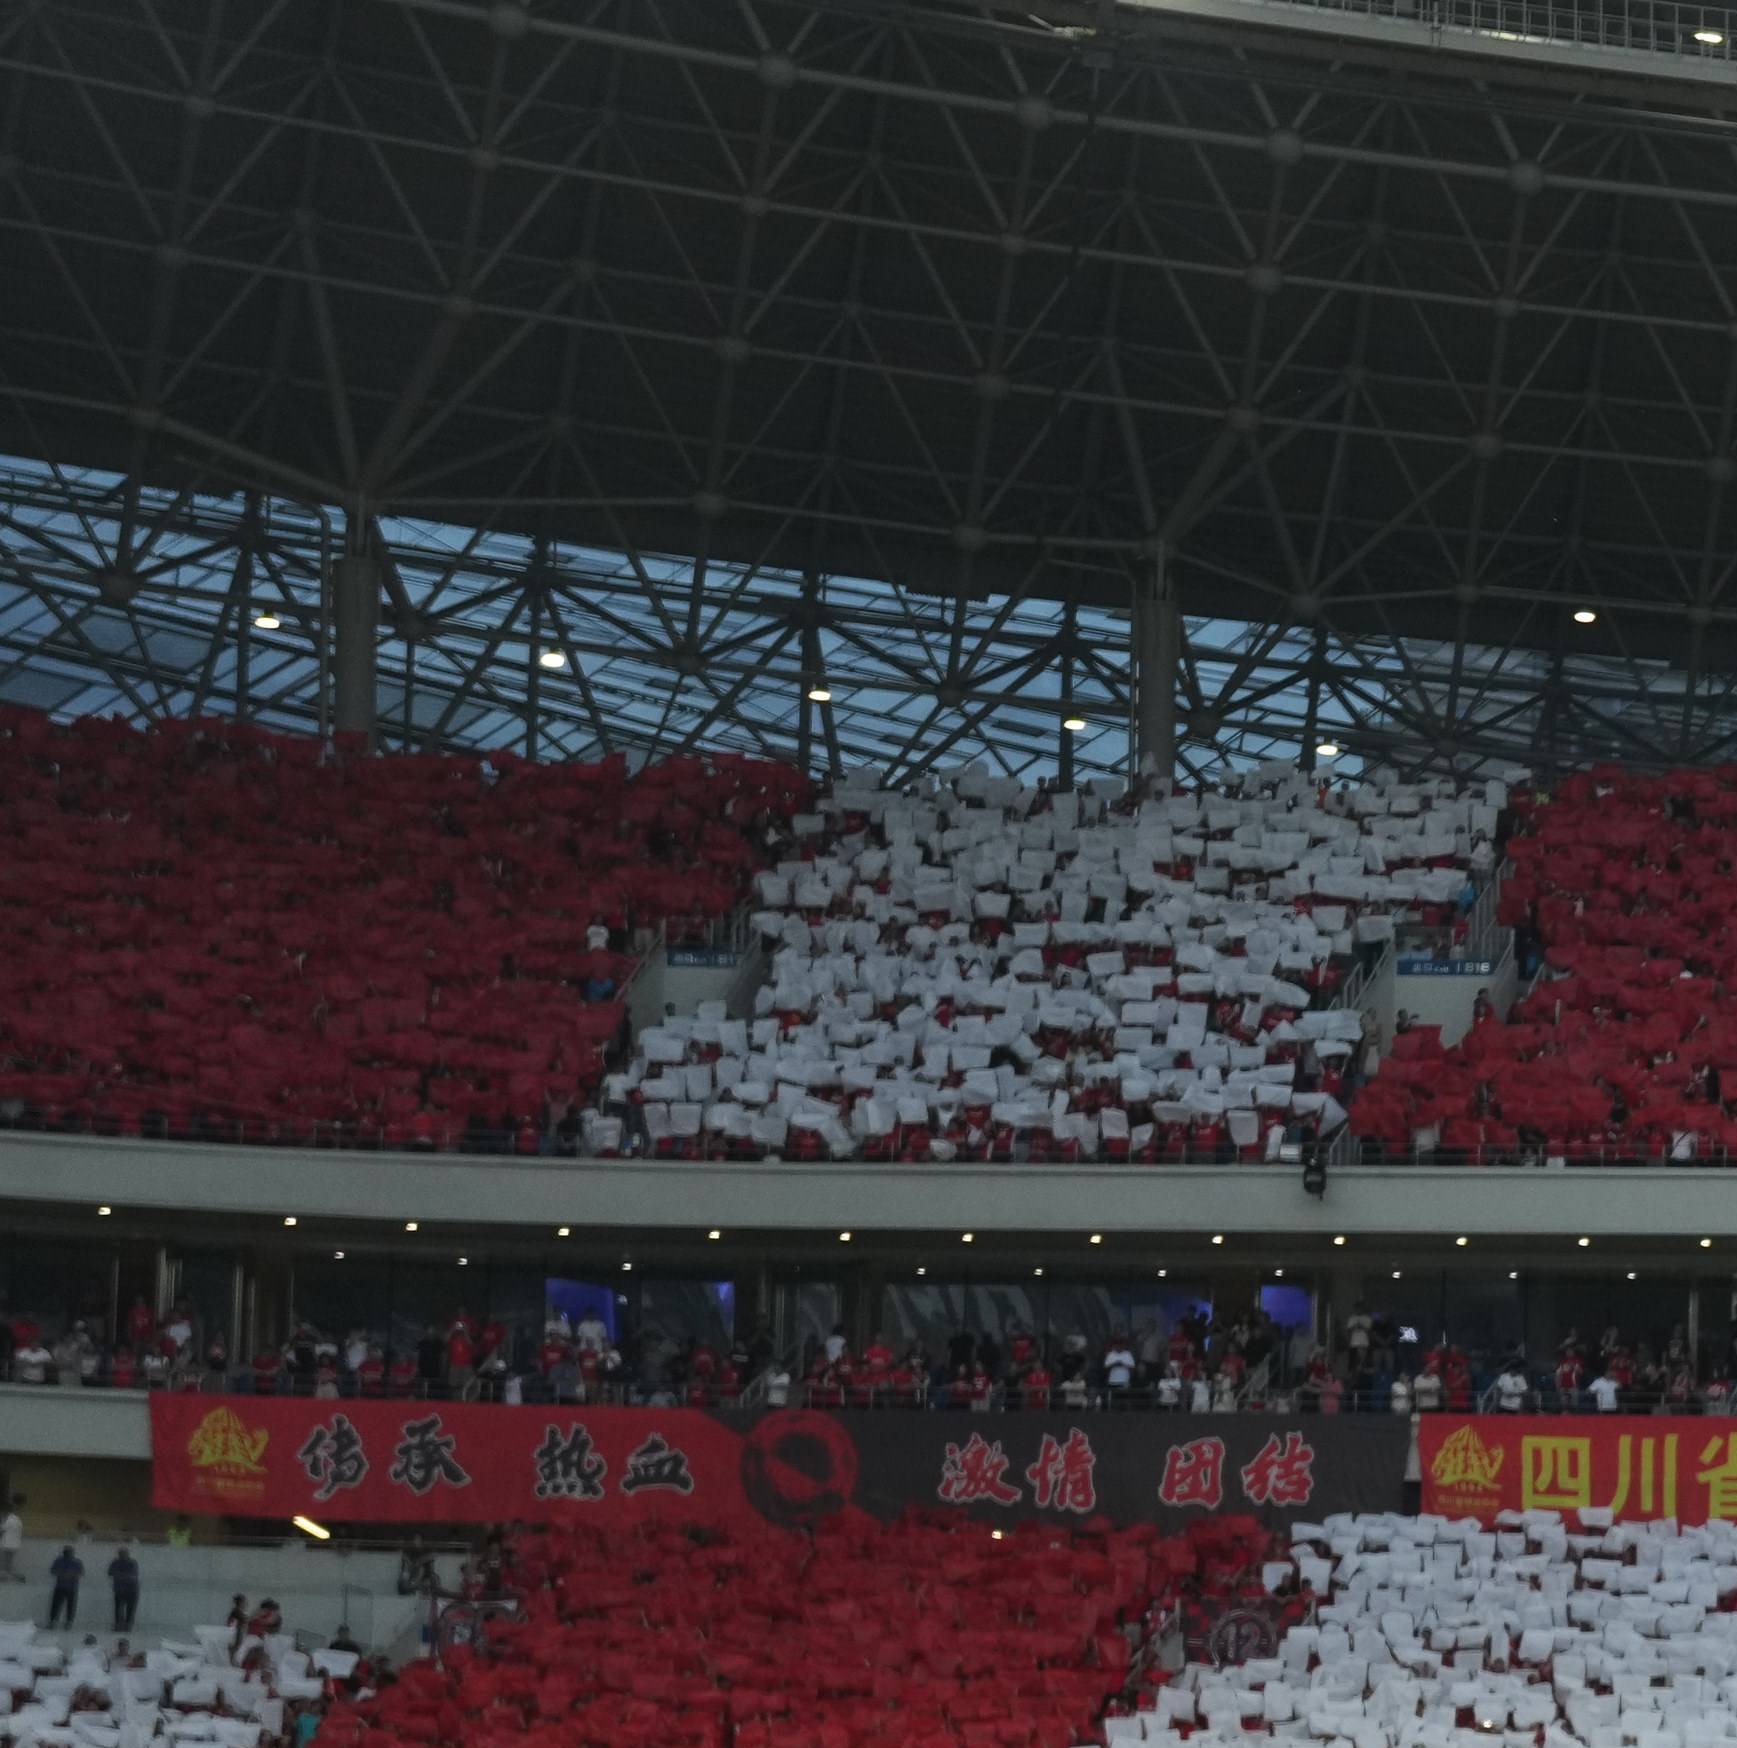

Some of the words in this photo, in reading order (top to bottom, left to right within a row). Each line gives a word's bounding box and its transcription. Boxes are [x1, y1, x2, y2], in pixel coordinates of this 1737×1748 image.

[534, 1422, 694, 1500] 热血
[938, 1428, 1097, 1513] 激情
[1159, 1430, 1314, 1511] 团结
